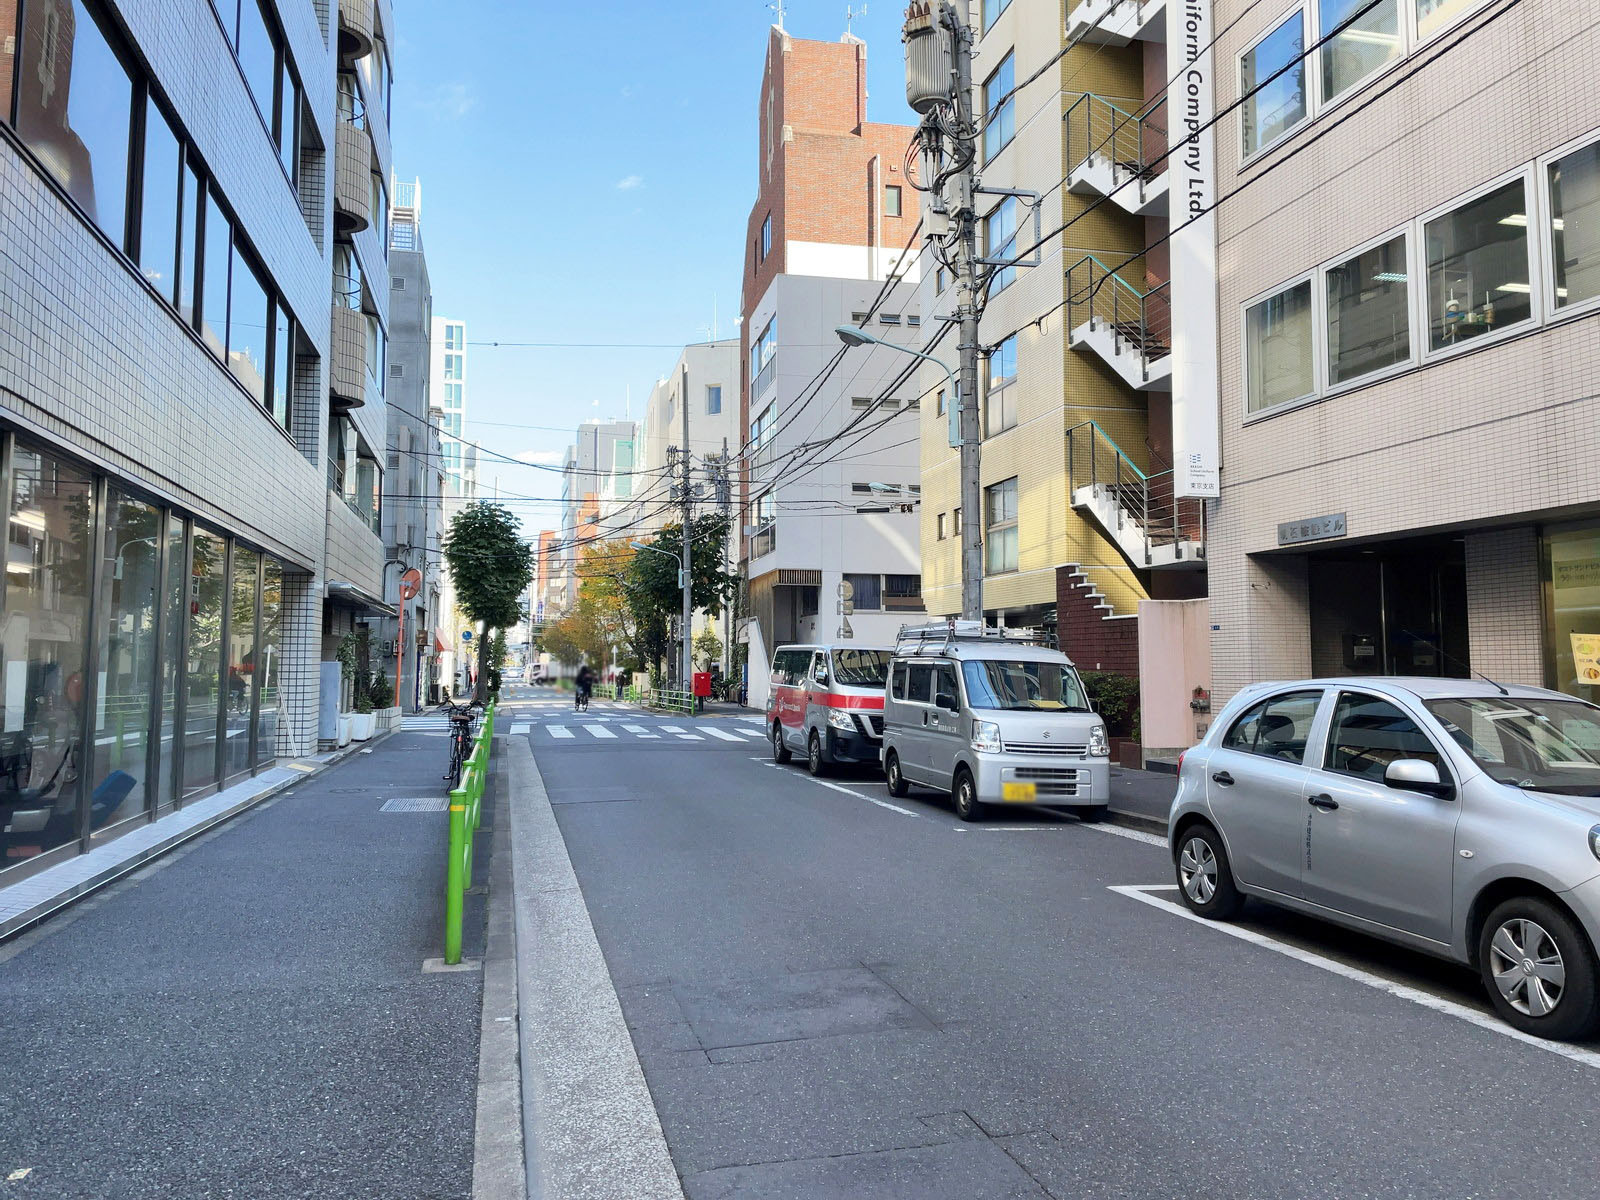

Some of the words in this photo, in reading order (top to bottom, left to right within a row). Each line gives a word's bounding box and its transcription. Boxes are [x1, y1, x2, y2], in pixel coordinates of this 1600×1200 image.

[1186, 0, 1202, 61] iform
[1184, 70, 1203, 172] Company
[1189, 179, 1206, 219] Ltd.
[1190, 482, 1215, 490] 東京支店
